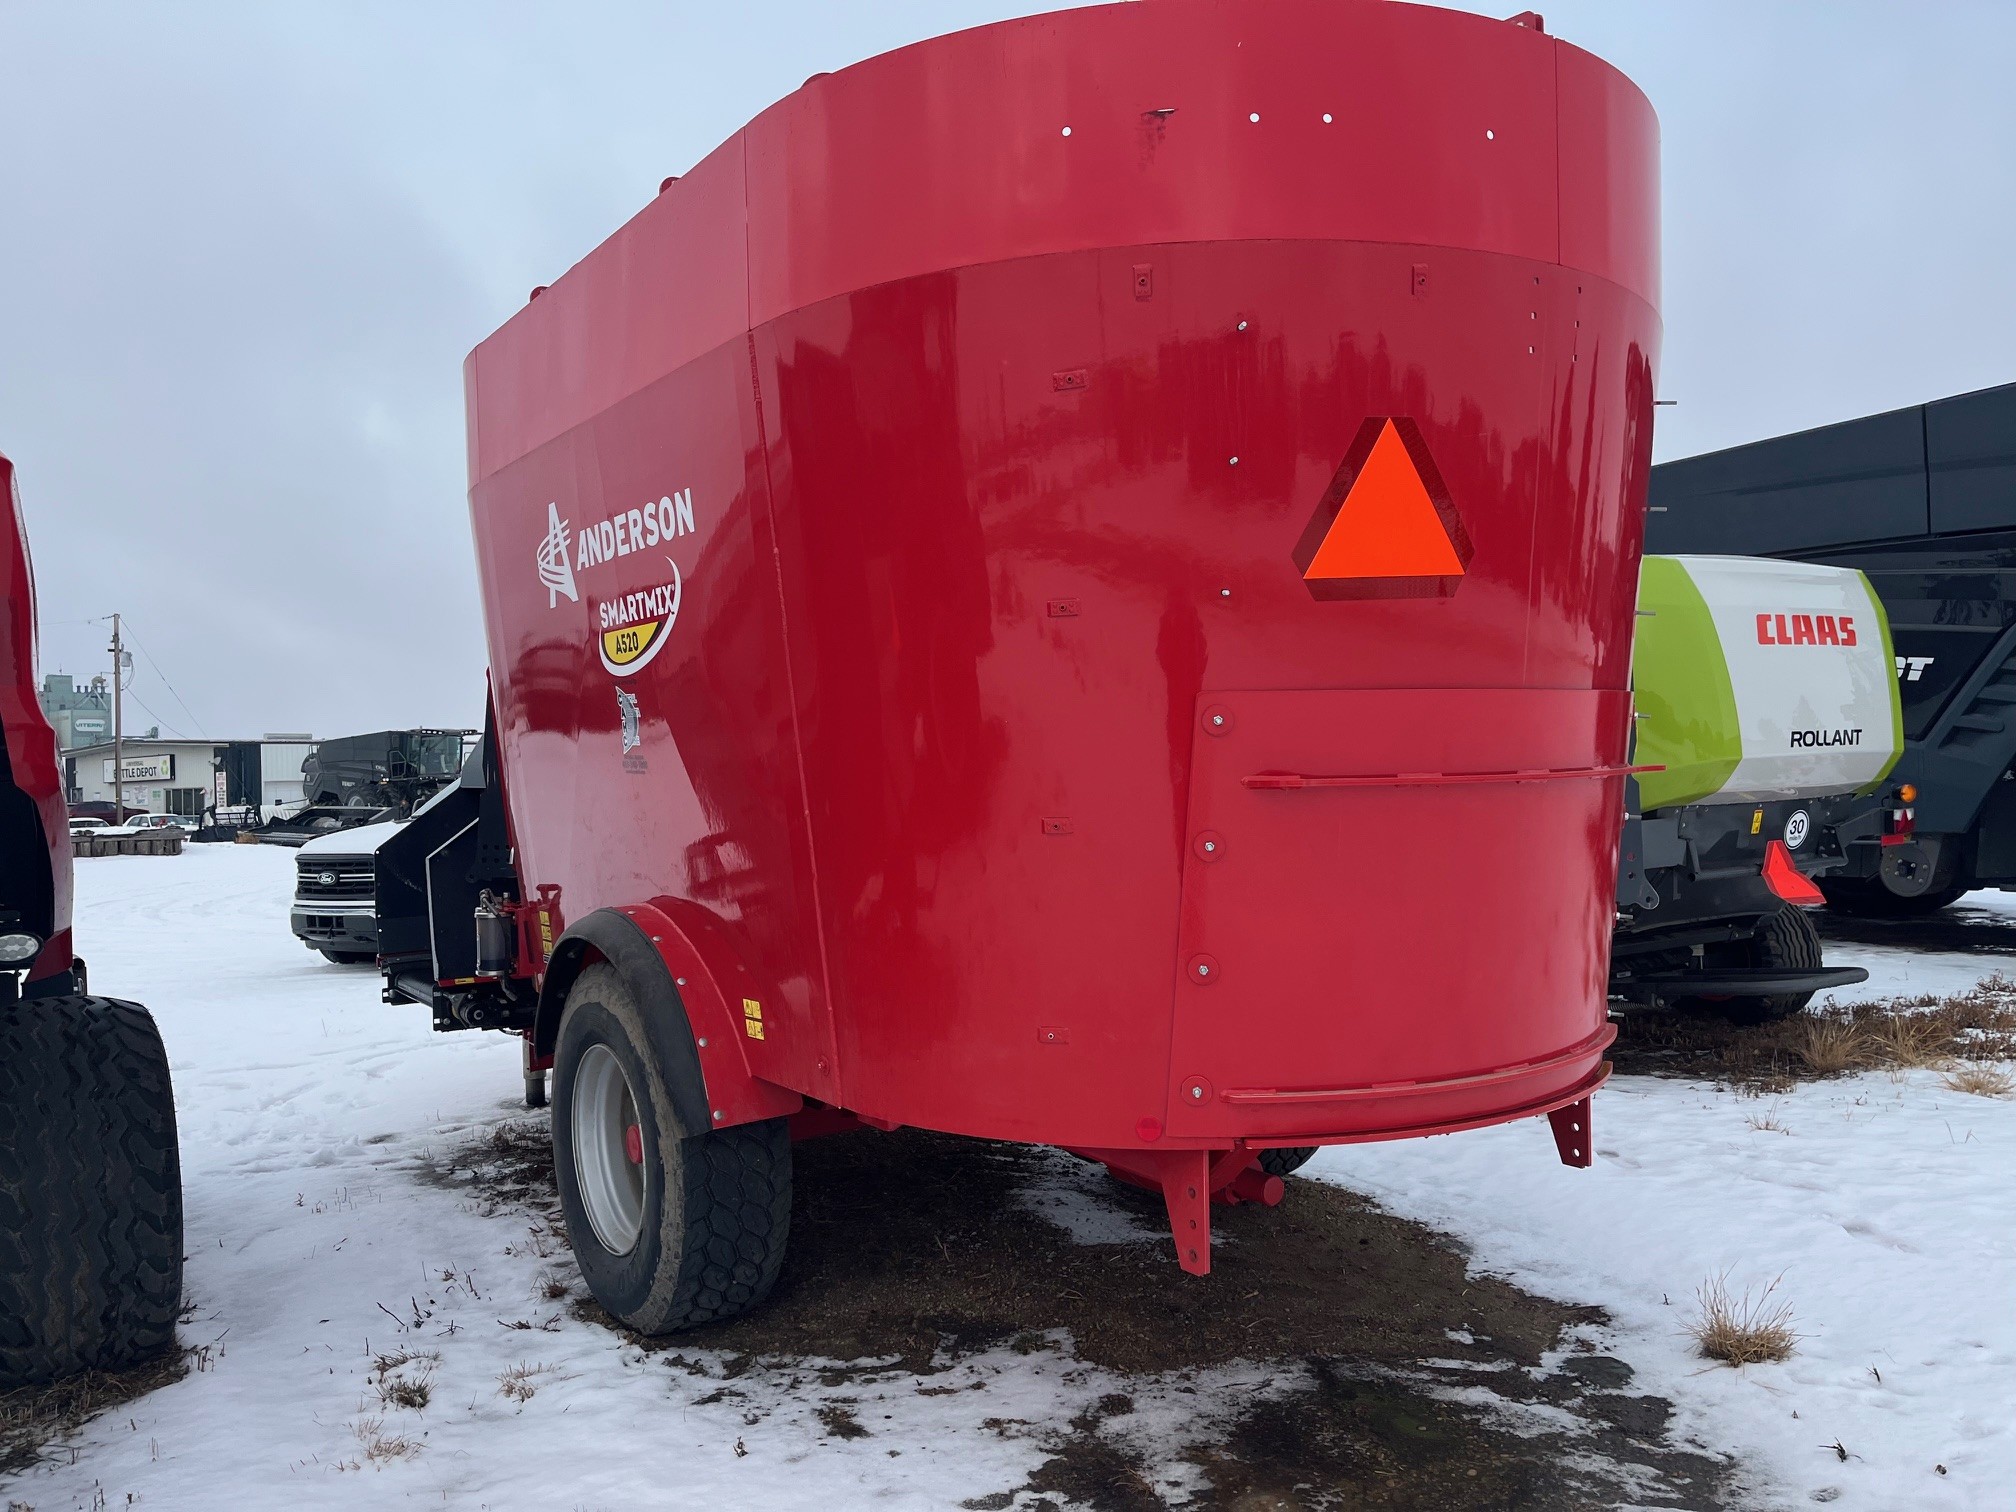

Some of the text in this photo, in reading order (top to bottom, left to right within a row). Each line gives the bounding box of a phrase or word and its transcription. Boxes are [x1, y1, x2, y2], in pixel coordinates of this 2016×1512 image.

[577, 487, 695, 572] ANDERSON
[599, 584, 675, 629] SMARTMIX
[1756, 614, 1857, 646] CLAAS
[616, 631, 639, 655] A520
[1790, 729, 1863, 748] ROLLANT
[113, 767, 157, 778] BTTLE DEPOT
[1789, 819, 1805, 835] 30
